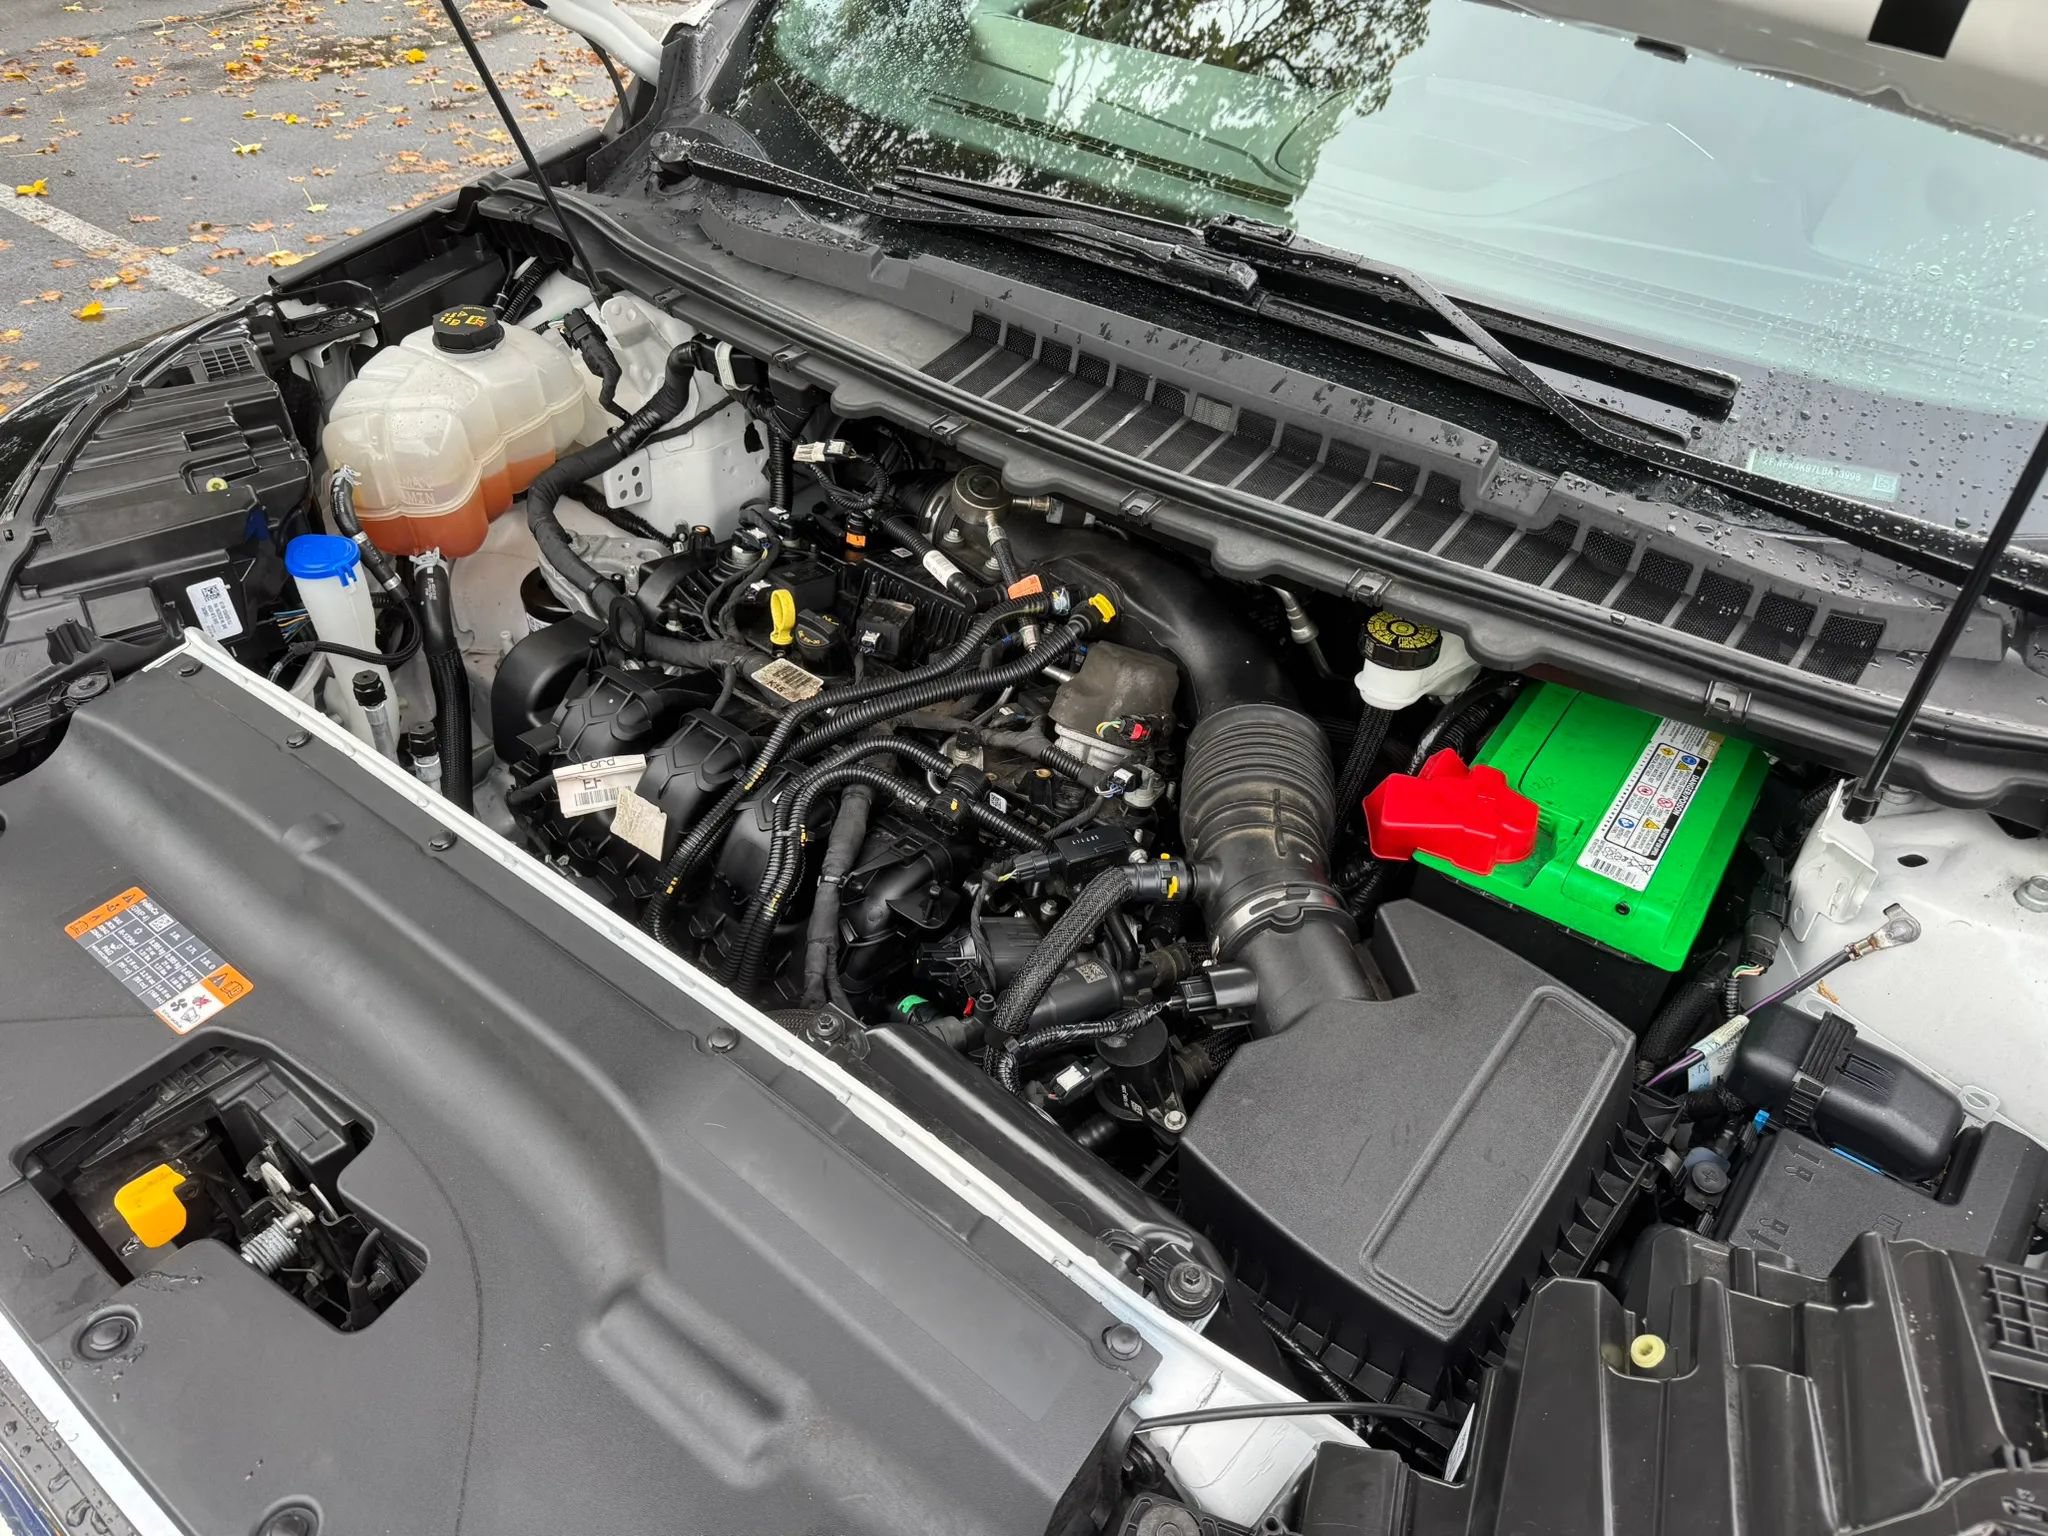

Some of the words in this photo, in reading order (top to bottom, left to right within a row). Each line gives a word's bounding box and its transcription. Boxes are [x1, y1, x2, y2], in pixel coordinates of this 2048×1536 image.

[581, 756, 616, 771] Ford
[1671, 774, 1699, 816] DANGER/POISON
[138, 898, 161, 915] FoMoCo
